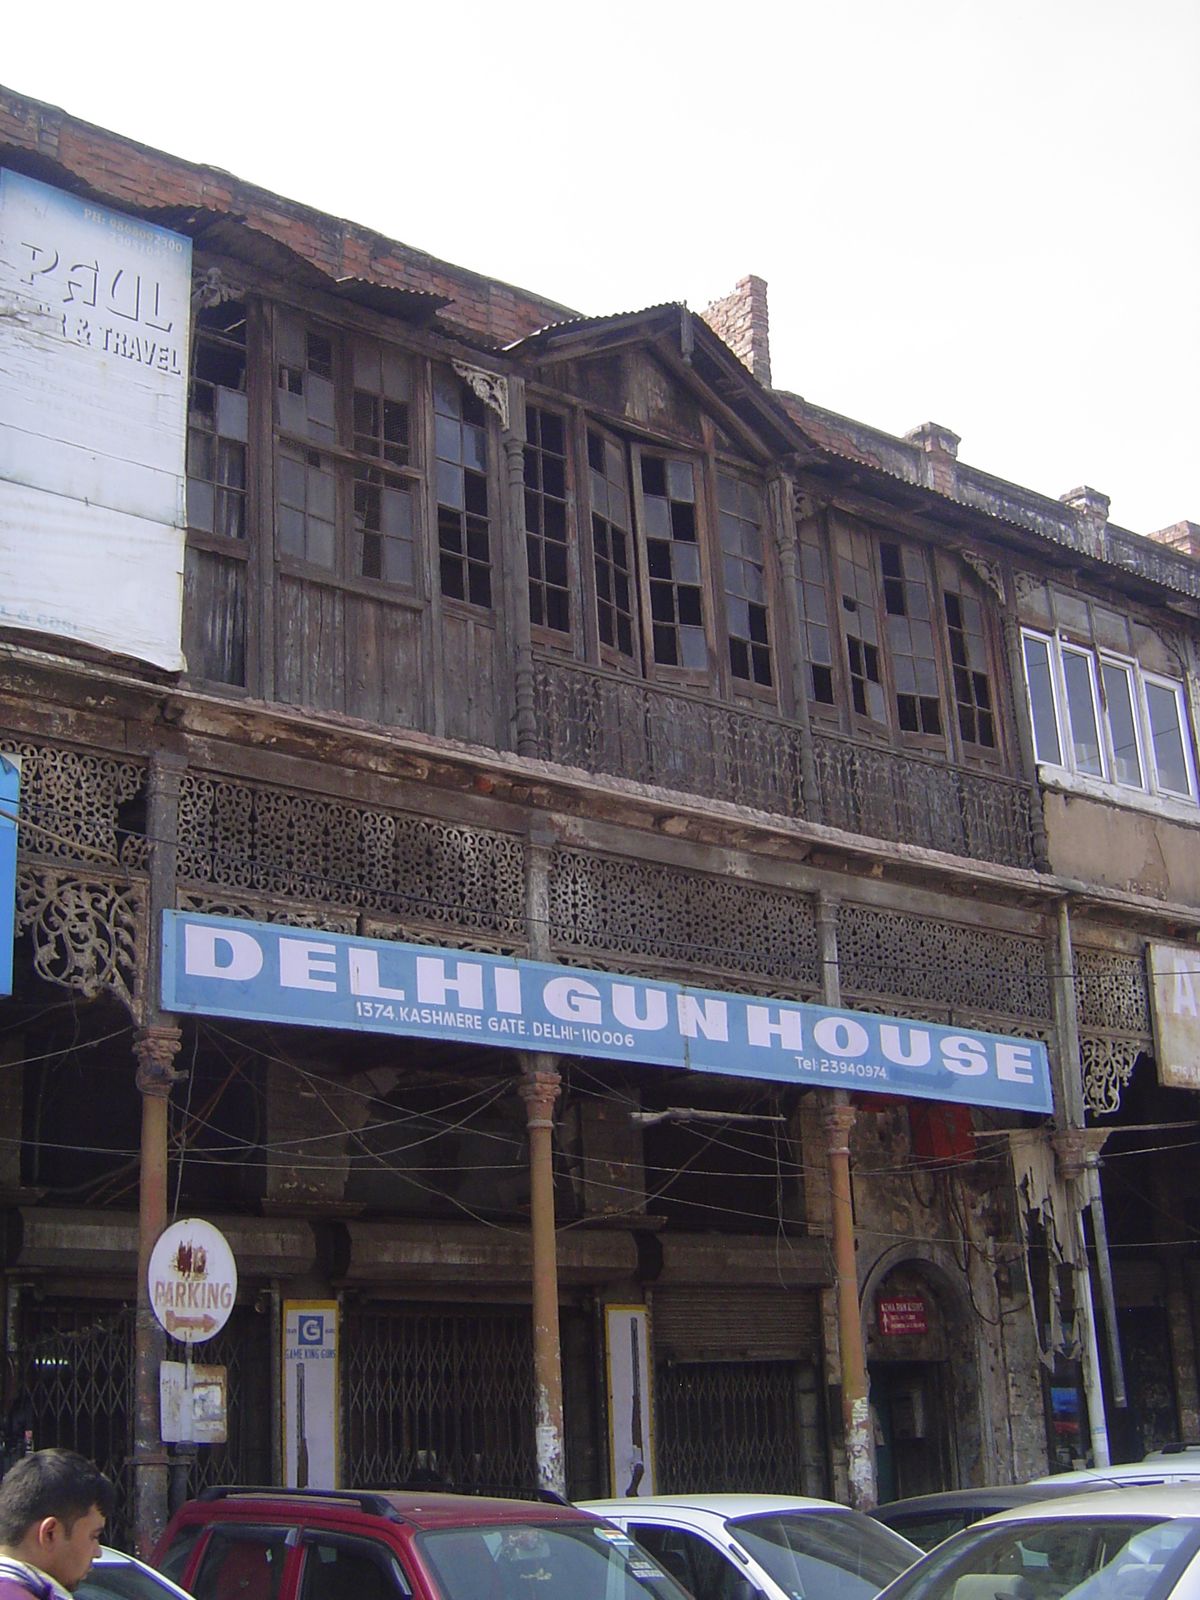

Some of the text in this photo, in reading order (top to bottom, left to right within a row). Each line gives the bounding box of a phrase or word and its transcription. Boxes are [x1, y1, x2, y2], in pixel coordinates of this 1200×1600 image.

[20, 242, 173, 333] PAUL
[99, 327, 182, 375] TRAVEL
[185, 923, 1034, 1084] DELHI GUN HOUSE
[154, 1280, 233, 1309] PARKING
